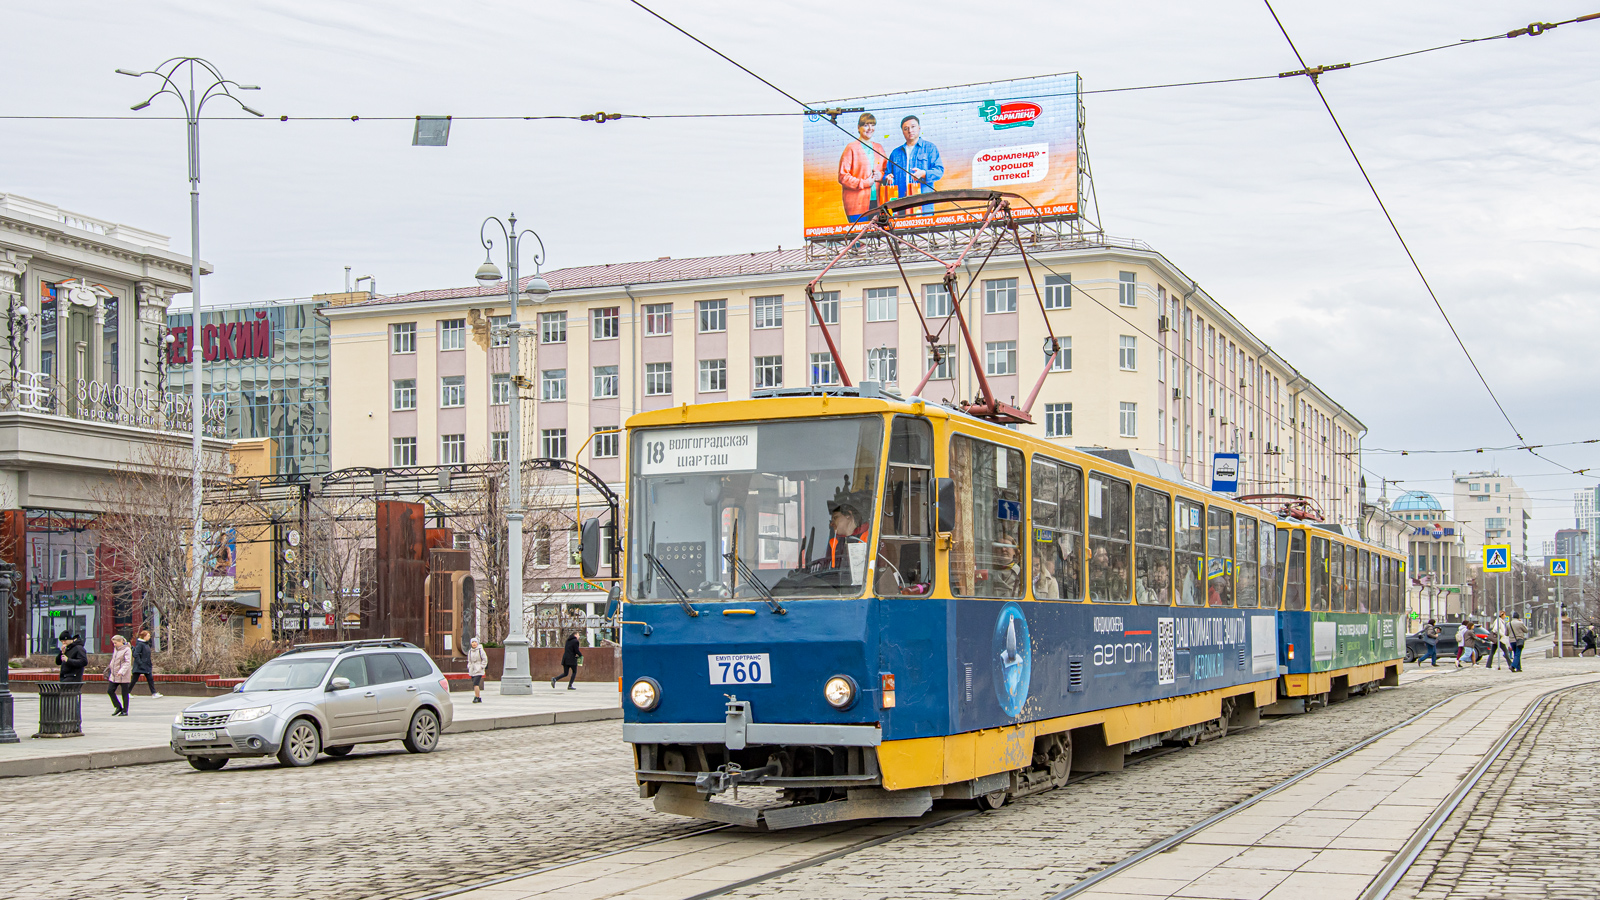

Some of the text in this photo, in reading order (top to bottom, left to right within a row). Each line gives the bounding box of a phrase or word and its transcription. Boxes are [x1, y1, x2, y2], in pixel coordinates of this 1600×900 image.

[991, 110, 1036, 121] ФАРМЛЕНД
[977, 151, 1040, 162] «Фармленд»
[989, 161, 1034, 172] хорошая
[993, 170, 1030, 181] аптека!
[77, 378, 155, 411] ЗОЛОТОЕ
[164, 419, 227, 434] супераркет
[647, 435, 749, 464] 18 ВОЛГОГРАДСКАЯ
[677, 454, 728, 467] ШАРТАШ
[1176, 617, 1189, 648] ВАШ
[1190, 617, 1212, 647] КЛИМАТ
[1212, 617, 1223, 650] ПОД
[1093, 642, 1153, 666] aeronik
[718, 661, 762, 683] 760
